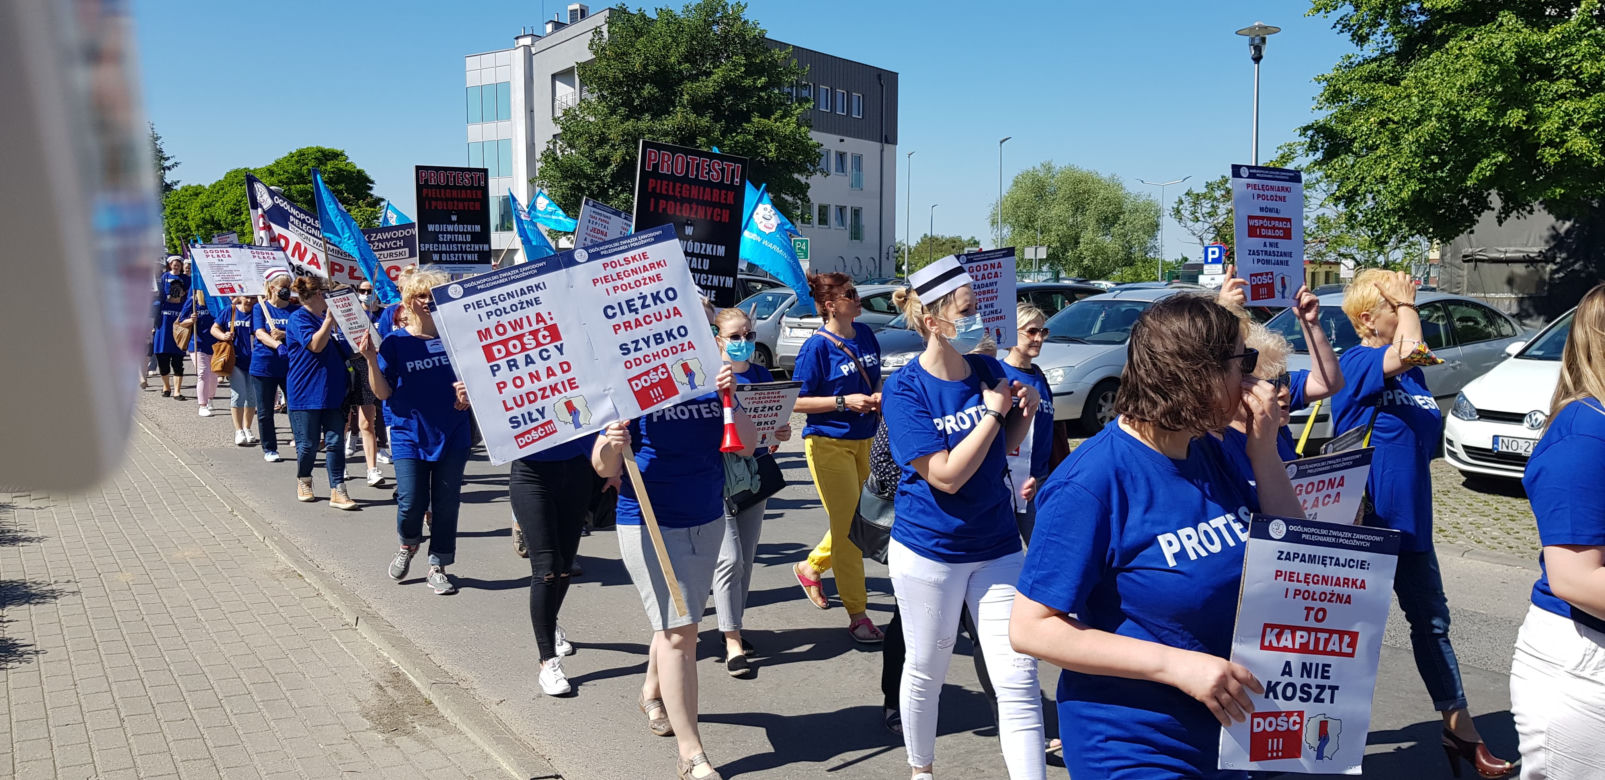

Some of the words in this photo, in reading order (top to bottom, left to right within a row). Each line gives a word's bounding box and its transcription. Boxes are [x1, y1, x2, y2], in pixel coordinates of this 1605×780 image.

[646, 148, 742, 186] PROTEST!
[418, 170, 485, 187] PROTEST!
[1246, 183, 1292, 193] PIELĘGNIARKI
[422, 188, 483, 199] PIELĘGNIAREK
[648, 179, 735, 205] PIELĘGNIAREK
[1257, 193, 1287, 203] POŁOŻNE
[425, 201, 429, 210] I
[431, 200, 481, 210] POŁOŻNYCH
[650, 200, 655, 212] I
[658, 201, 730, 223] POŁOŻNYCH
[274, 196, 321, 228] OGÓLNOPOLS
[371, 228, 416, 241] ZAWODOW
[427, 223, 481, 232] WOJEWÓDZKIM
[1248, 218, 1291, 229] WSPÓŁPRACA
[289, 215, 323, 238] PIELĘGNIA
[369, 239, 404, 251] OŻNYCH
[438, 234, 471, 242] SZPITALU
[590, 227, 608, 238] JEDNA
[684, 225, 694, 236] W
[1261, 228, 1284, 236] DIALOG
[420, 243, 489, 251] SPECJALISTYCZNYM
[680, 240, 725, 257] WÓDZKIM
[796, 241, 806, 252] P4
[1207, 247, 1220, 263] P
[1247, 249, 1293, 258] ZASTRASZANIE
[1268, 241, 1279, 249] NIE
[432, 253, 440, 261] W
[441, 253, 478, 261] OLSZTYNIE
[602, 251, 650, 271] POLSKIE
[686, 256, 710, 270] TALU
[968, 261, 1002, 273] GODNA
[1256, 259, 1290, 267] POMIJANIE
[592, 259, 667, 287] PIELĘGNIARKI
[1251, 273, 1273, 285] DOŚĆ
[605, 288, 610, 296] I
[612, 273, 663, 294] POŁOŻNE
[1259, 287, 1268, 298] !!!
[463, 281, 547, 313] PIELĘGNIARKI
[603, 286, 678, 320] CIĘŻKO
[976, 295, 998, 303] STAWY
[478, 313, 483, 322] I
[485, 296, 543, 320] POŁOŻNE
[979, 309, 1003, 317] LEJNEJ
[982, 315, 1006, 323] WIZORKI
[476, 311, 554, 343] MÓWIĄ:
[612, 306, 683, 335] PRACUJĄ
[491, 328, 552, 359] DOŚĆ
[619, 325, 689, 356] SZYBKO
[406, 356, 449, 373] PROTE
[489, 343, 566, 377] PRACY
[624, 340, 696, 370] ODCHODZĄ
[496, 361, 572, 395] PONAD
[631, 366, 669, 392] DOŚĆ
[502, 377, 580, 413] LUDZKIE
[649, 386, 665, 403] !!!
[508, 406, 546, 430] SIŁY
[652, 401, 720, 423] PROTES
[933, 404, 988, 435] PROTE
[517, 423, 556, 445] DOŚĆ!!!
[1501, 438, 1519, 451] NO
[1294, 475, 1345, 497] GODNA
[1301, 491, 1341, 511] ŁACA
[1157, 505, 1251, 568] PROTES
[1288, 525, 1329, 535] OGÓLNOPOLSKI
[1328, 529, 1353, 538] ZWIĄZEK
[1353, 533, 1384, 542] ZAWODOWY
[1301, 534, 1336, 543] PIELĘGNIAREK
[1339, 538, 1370, 547] POŁOŻNYCH
[1276, 550, 1371, 571] ZAPAMIĘTAJCIE:
[1274, 569, 1367, 590] PIELĘGNIARKA
[1284, 587, 1289, 599] I
[1292, 588, 1352, 605] POŁOŻNA
[1303, 606, 1328, 623] TO
[1263, 627, 1354, 653] KAPITAŁ
[1280, 660, 1293, 677] A
[1300, 662, 1332, 680] NIE
[1264, 680, 1340, 704] KOSZT
[1253, 712, 1301, 733] DOŚĆ
[1267, 737, 1284, 757] !!!
